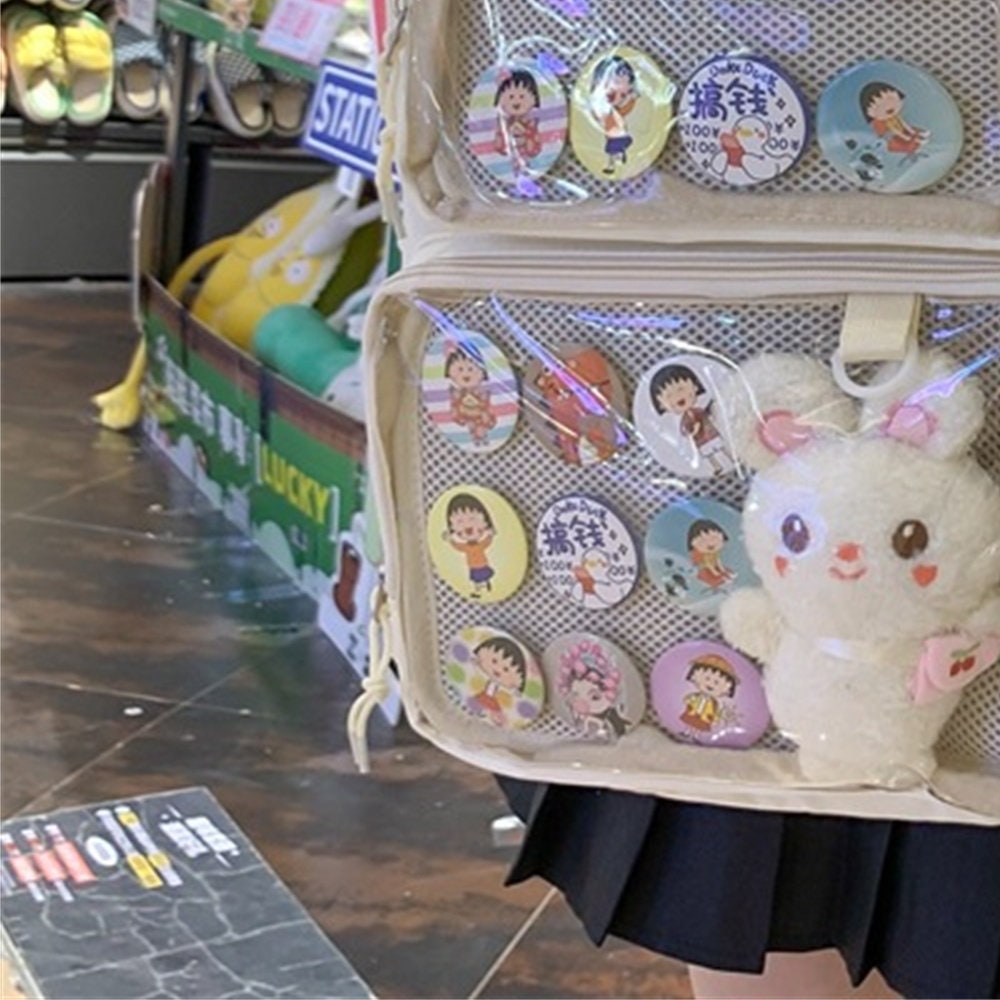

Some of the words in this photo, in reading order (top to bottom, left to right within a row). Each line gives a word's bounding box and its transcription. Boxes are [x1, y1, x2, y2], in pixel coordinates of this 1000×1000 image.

[688, 77, 777, 122] 搞钱
[262, 443, 329, 524] LUCKY
[540, 514, 608, 556] 搞钱
